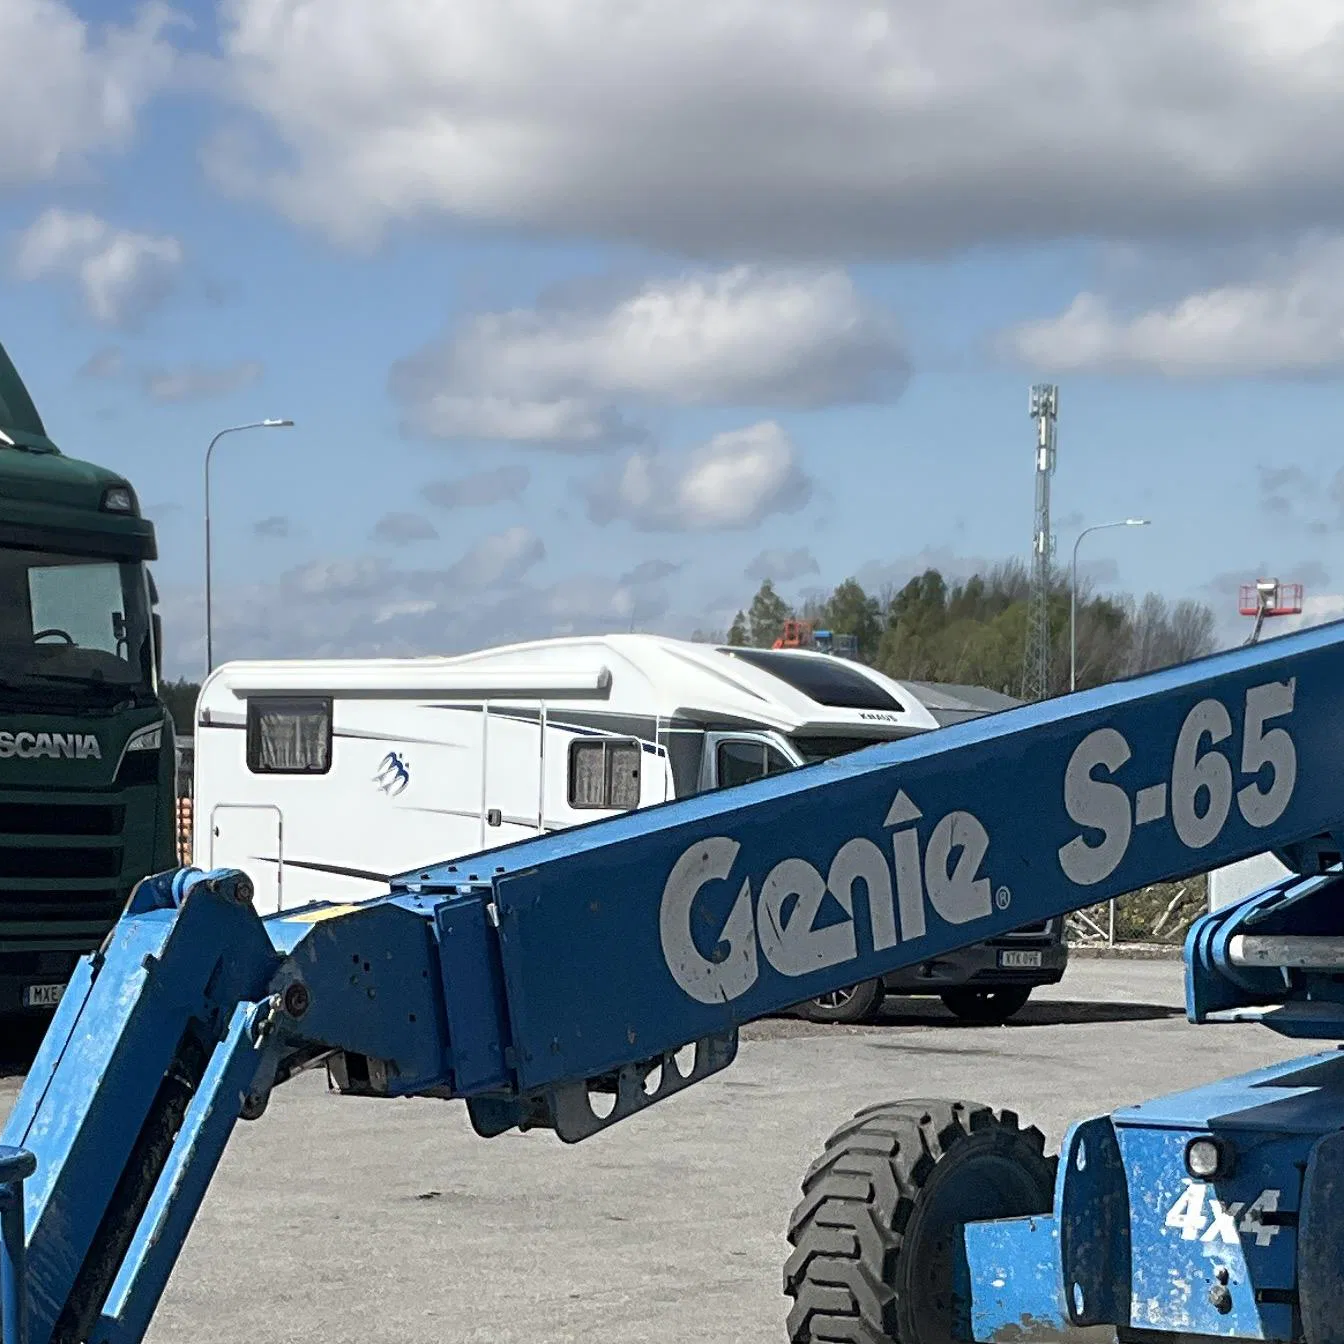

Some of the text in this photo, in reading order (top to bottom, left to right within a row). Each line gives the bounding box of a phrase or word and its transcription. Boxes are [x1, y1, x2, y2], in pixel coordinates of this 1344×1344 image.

[660, 677, 1297, 1004] Genie S-65
[1165, 1180, 1281, 1247] 4x4
